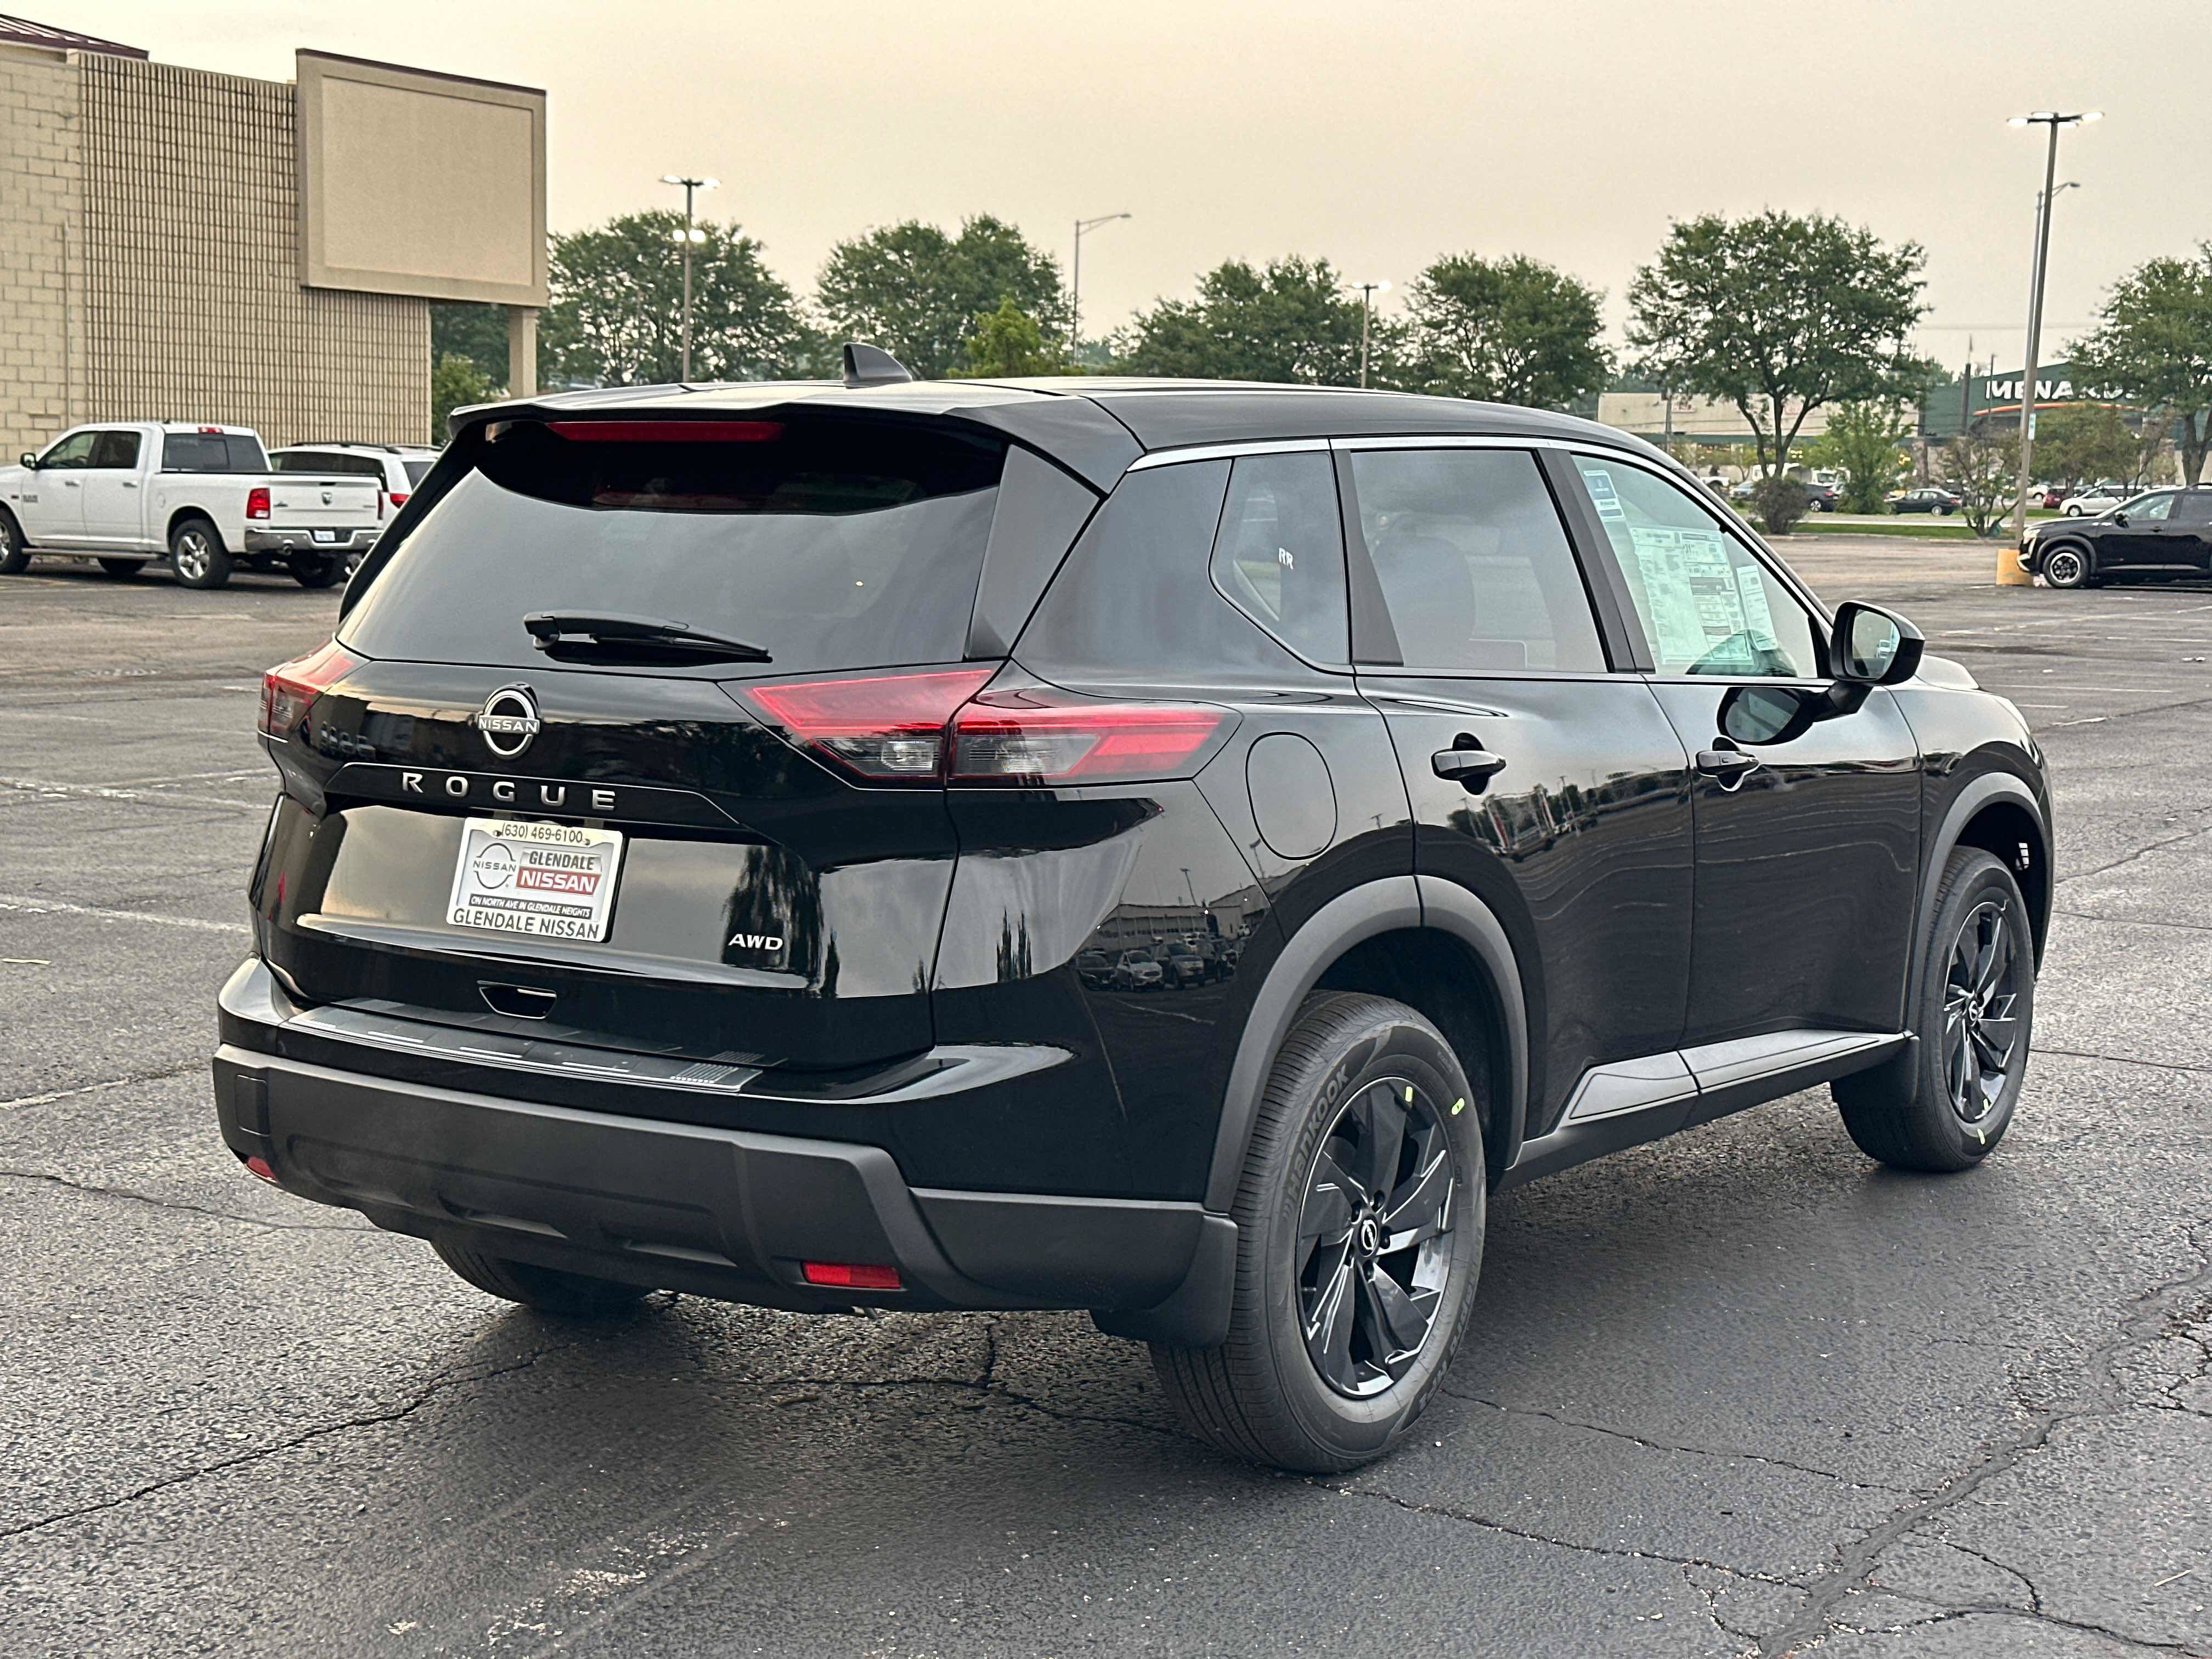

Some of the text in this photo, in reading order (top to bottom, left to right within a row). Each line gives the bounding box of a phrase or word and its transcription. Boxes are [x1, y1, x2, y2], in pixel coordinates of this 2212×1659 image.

[478, 719, 538, 732] NISSAN
[402, 772, 616, 811] ROGUE
[501, 822, 583, 844] (630) 469-6100
[472, 860, 516, 872] NISSAN
[529, 851, 595, 871] GLENDALE
[521, 870, 595, 893] NISSAN
[471, 896, 590, 918] ON NORTH AVE IN GLENDALE HEIGHTS
[454, 907, 600, 939] GLENDALE NISSAN
[727, 933, 783, 950] AWD
